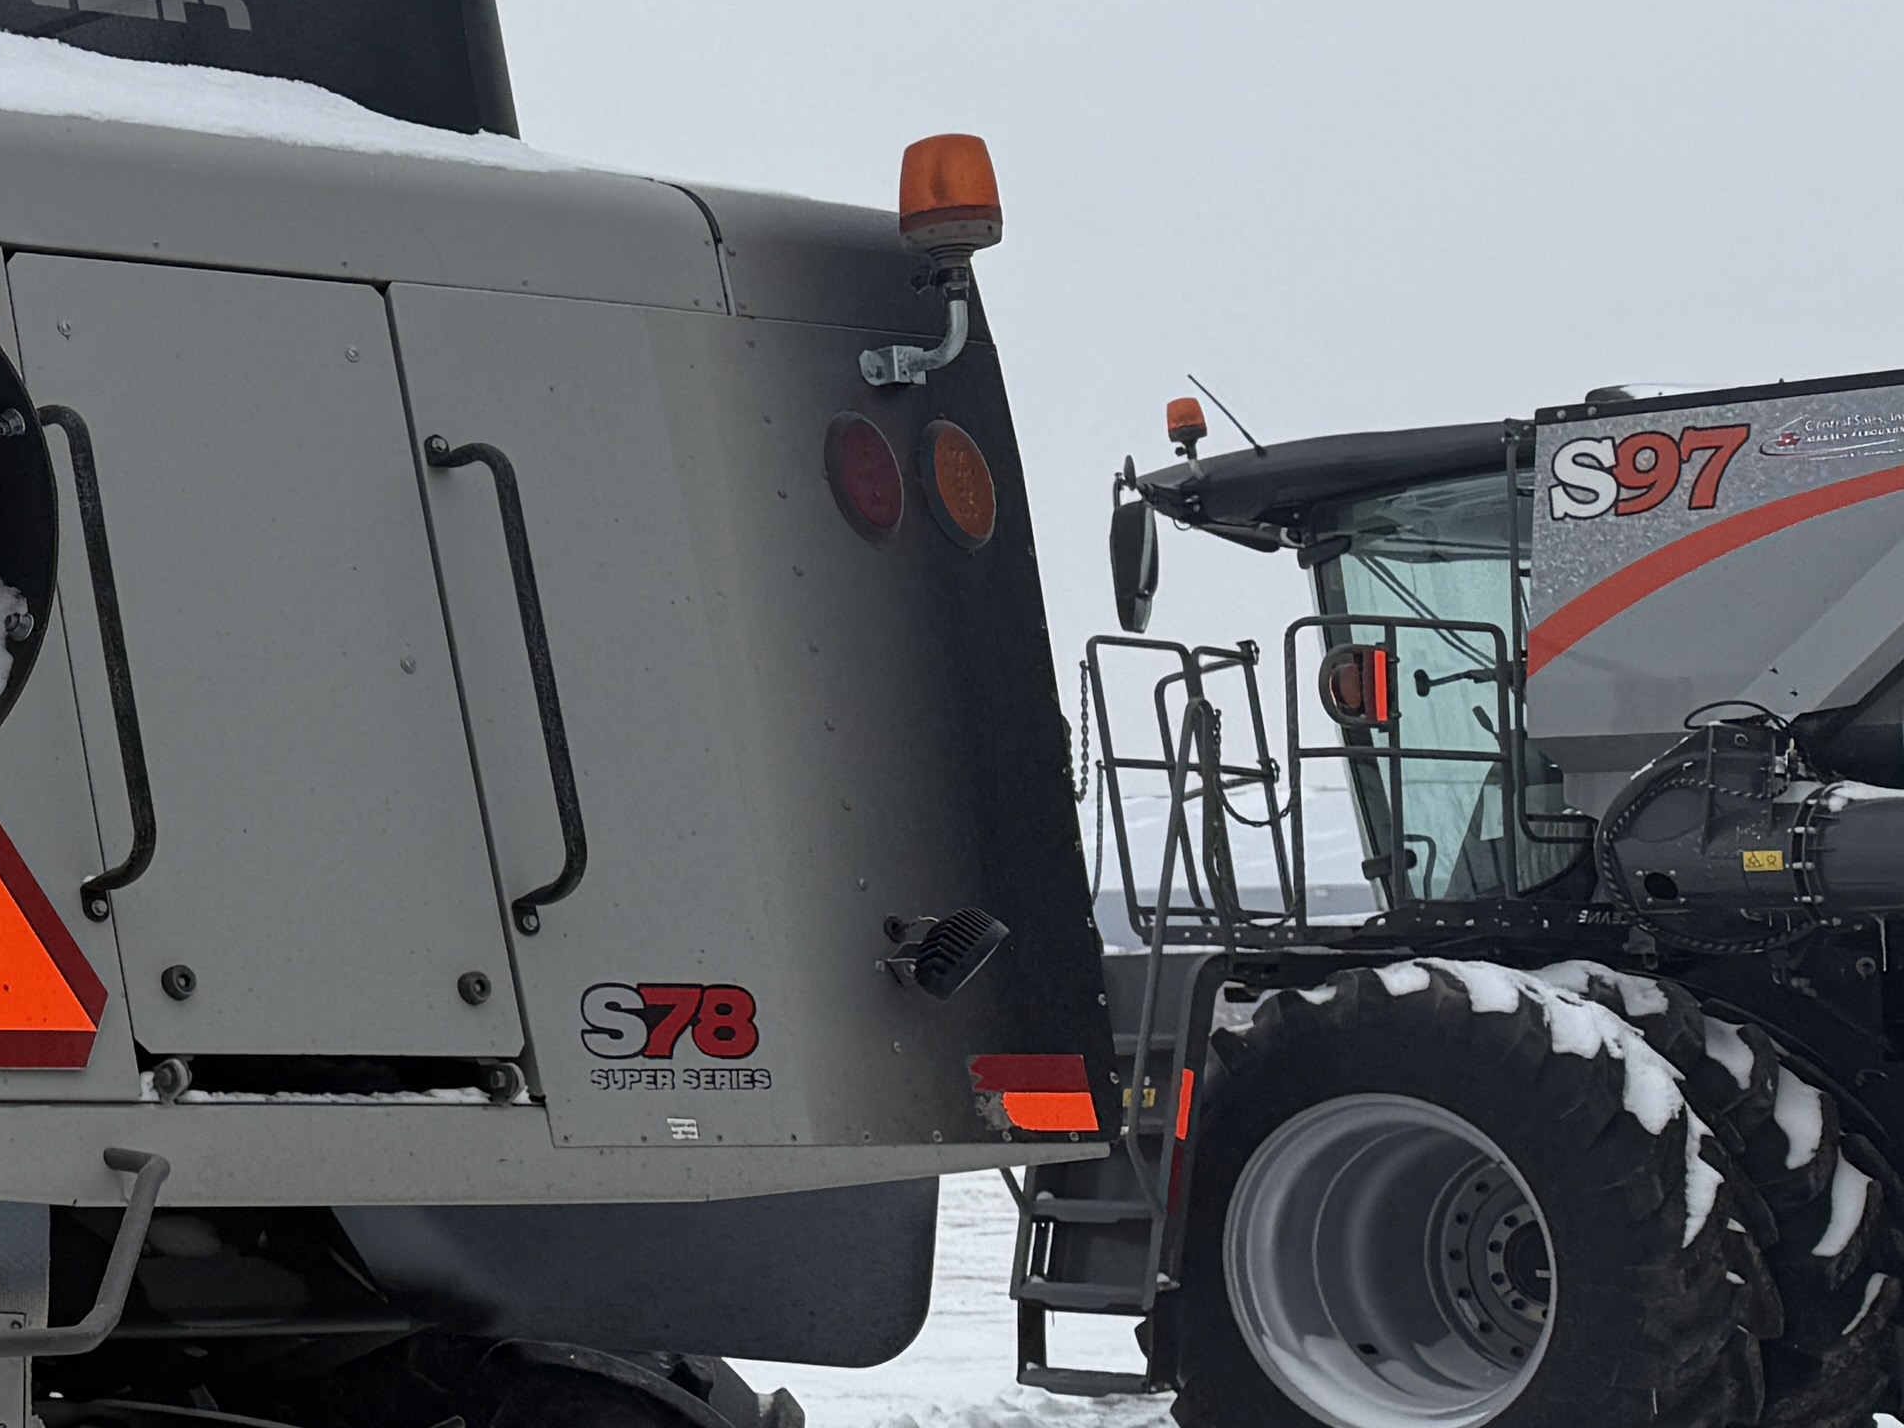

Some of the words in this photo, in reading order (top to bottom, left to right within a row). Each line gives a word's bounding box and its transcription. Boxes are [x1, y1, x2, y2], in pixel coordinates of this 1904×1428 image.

[1547, 423, 1752, 521] S97
[580, 982, 760, 1060] S78
[590, 1068, 676, 1091] SUPER
[682, 1068, 773, 1091] SERIES
